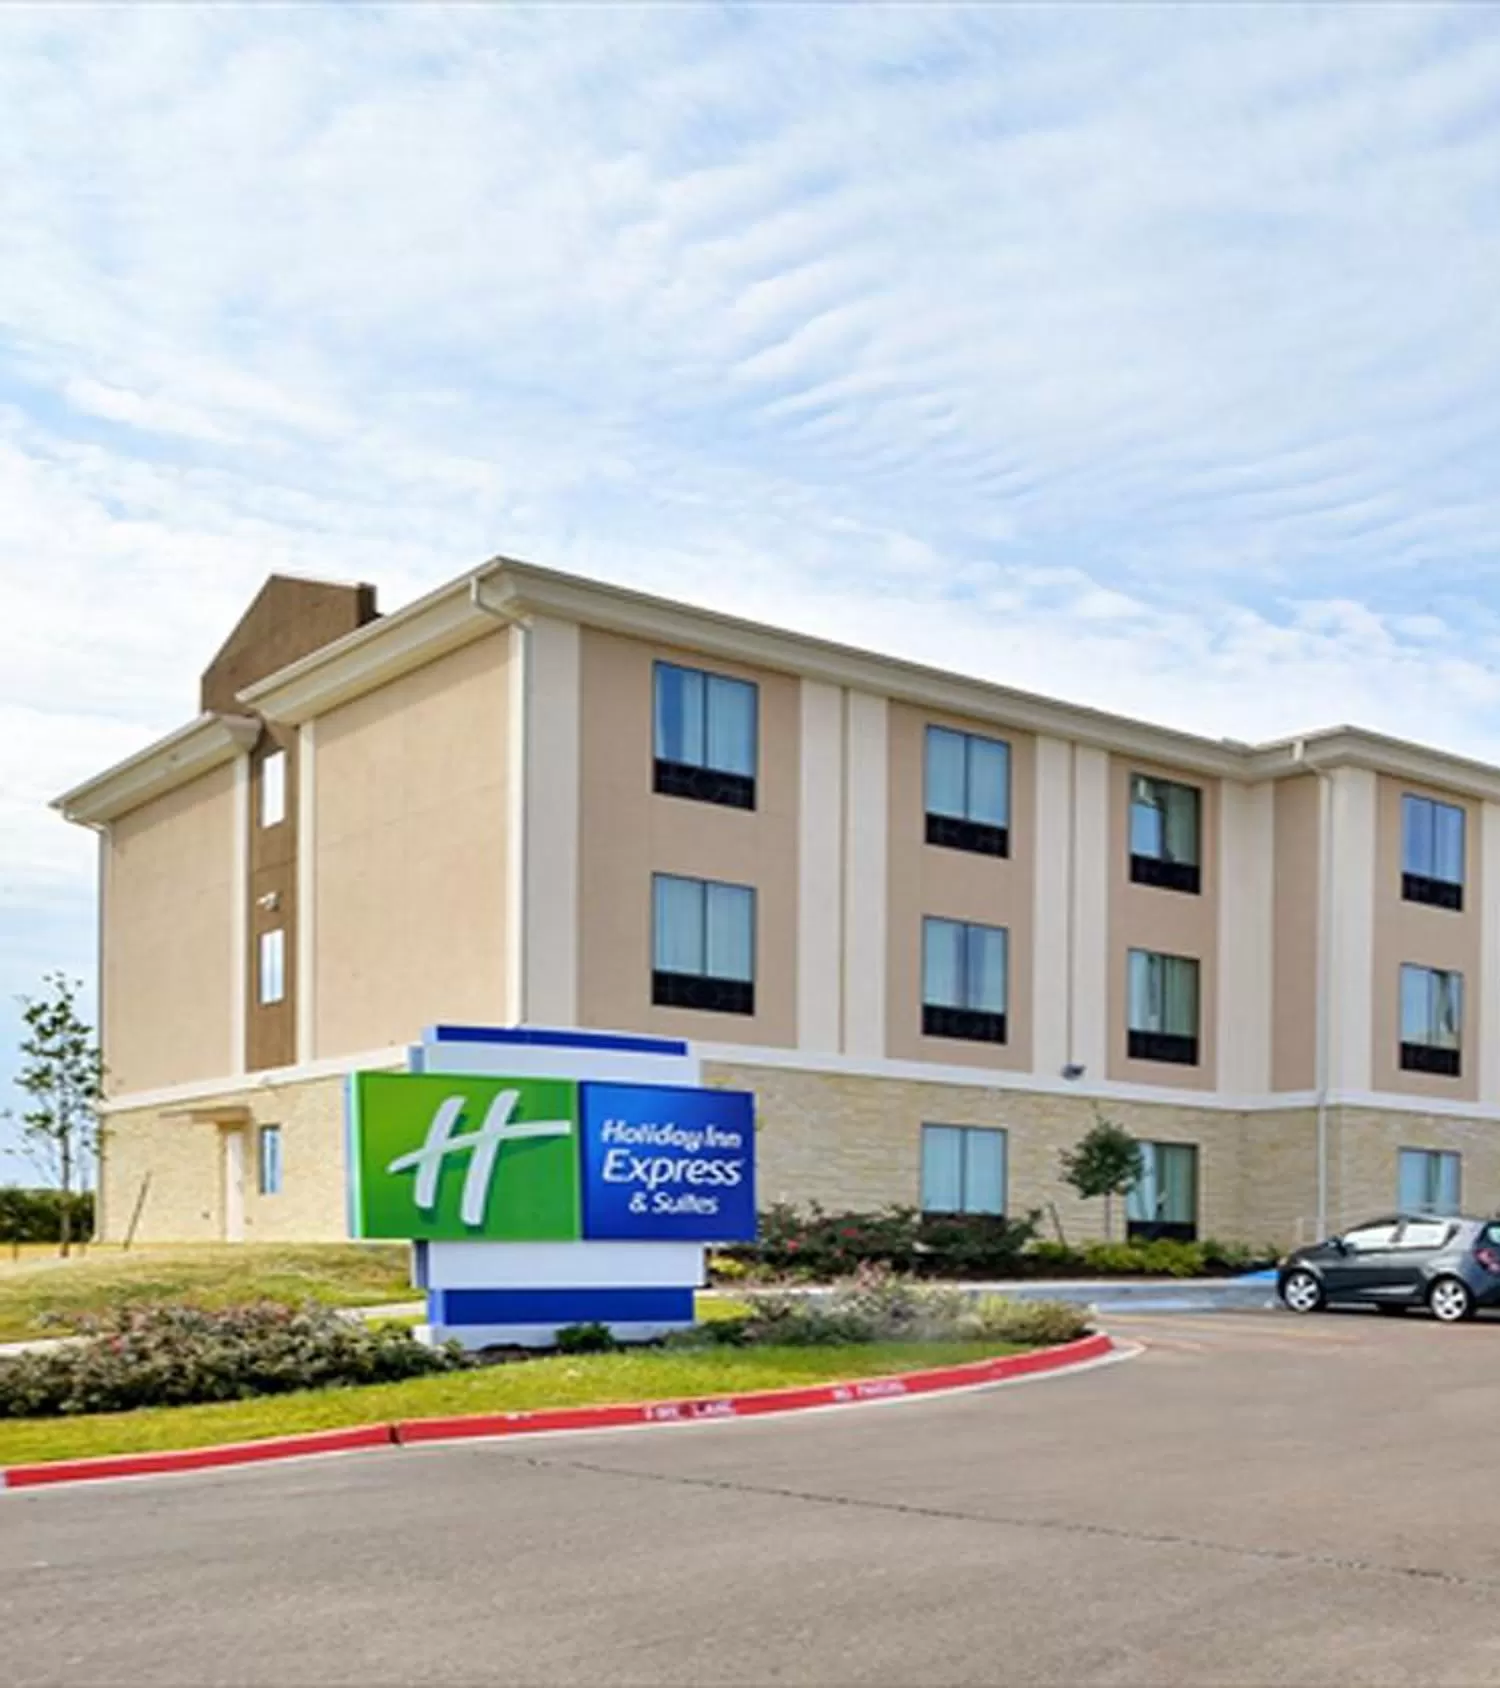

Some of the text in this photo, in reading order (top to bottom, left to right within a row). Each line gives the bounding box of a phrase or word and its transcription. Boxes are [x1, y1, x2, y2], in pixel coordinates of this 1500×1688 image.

[601, 1118, 743, 1152] Holiday Inn
[385, 1089, 572, 1226] H
[602, 1148, 744, 1191] Express
[628, 1191, 720, 1215] & Suites
